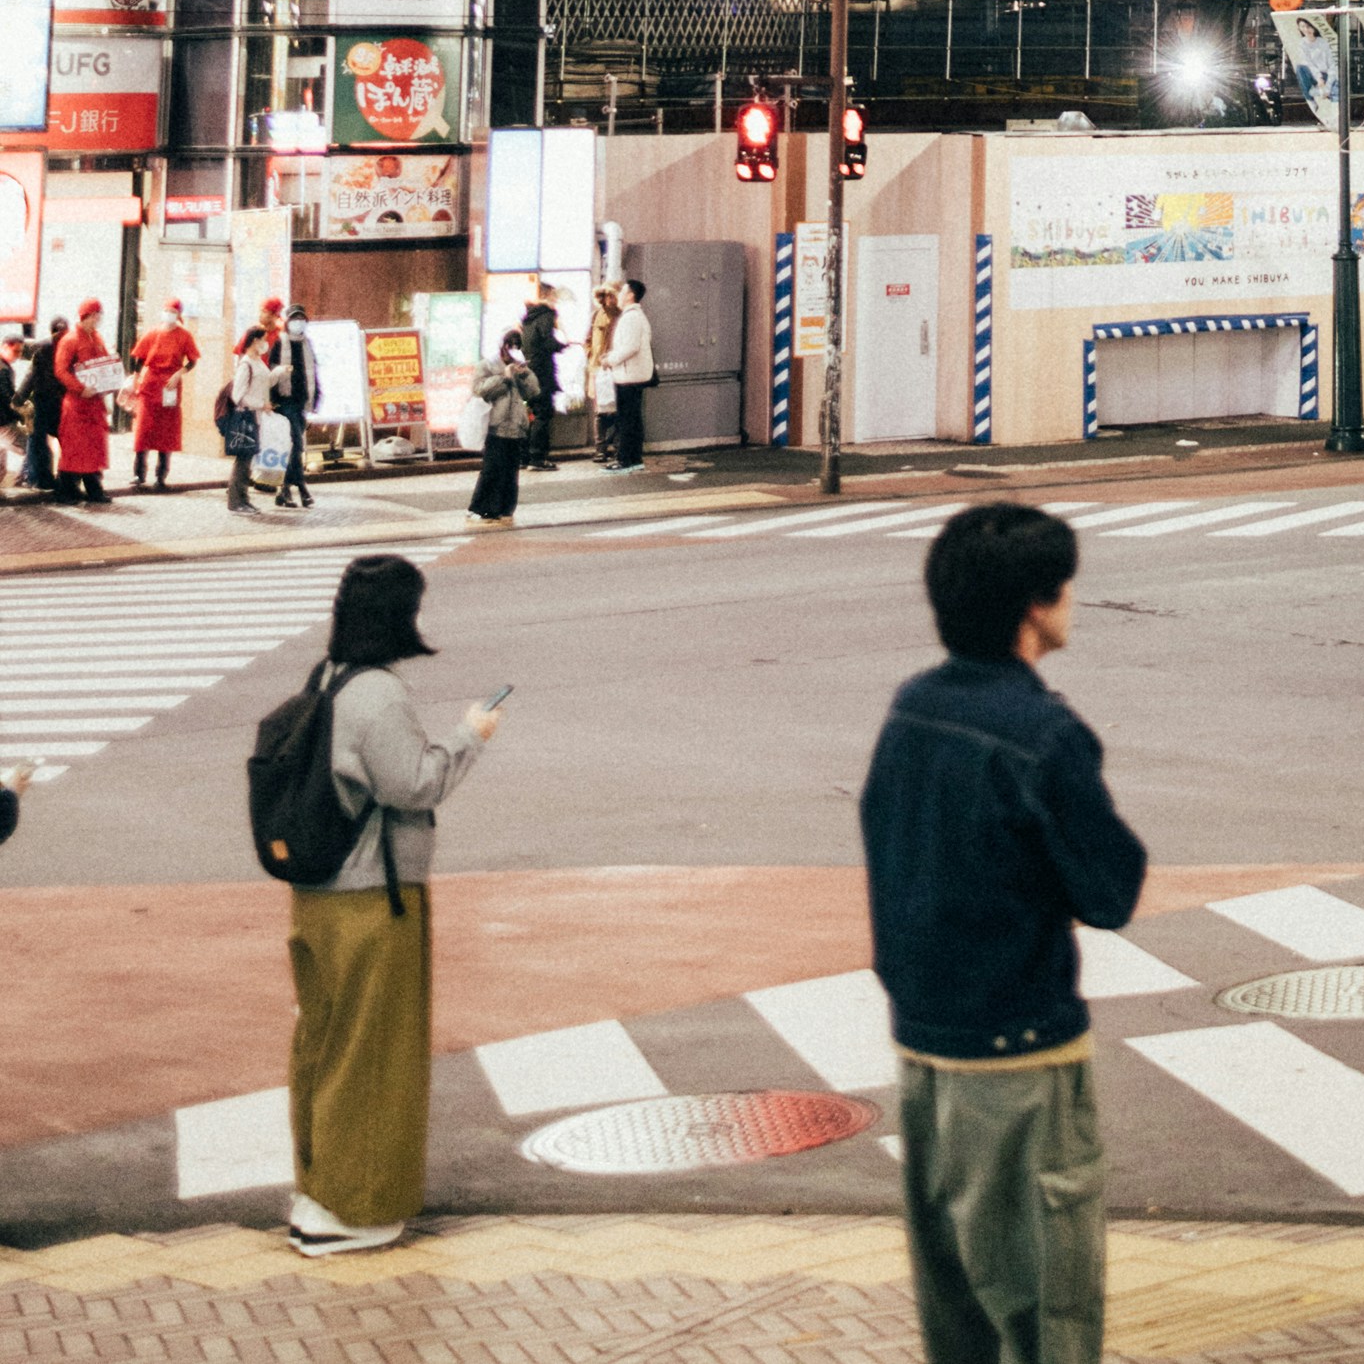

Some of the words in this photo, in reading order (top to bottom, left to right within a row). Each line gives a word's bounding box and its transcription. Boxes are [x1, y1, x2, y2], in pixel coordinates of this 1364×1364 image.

[337, 188, 453, 209] 自然派インド料理
[1184, 277, 1205, 287] YOU
[1211, 275, 1241, 286] MAKE
[1247, 273, 1290, 285] SHIBUYA
